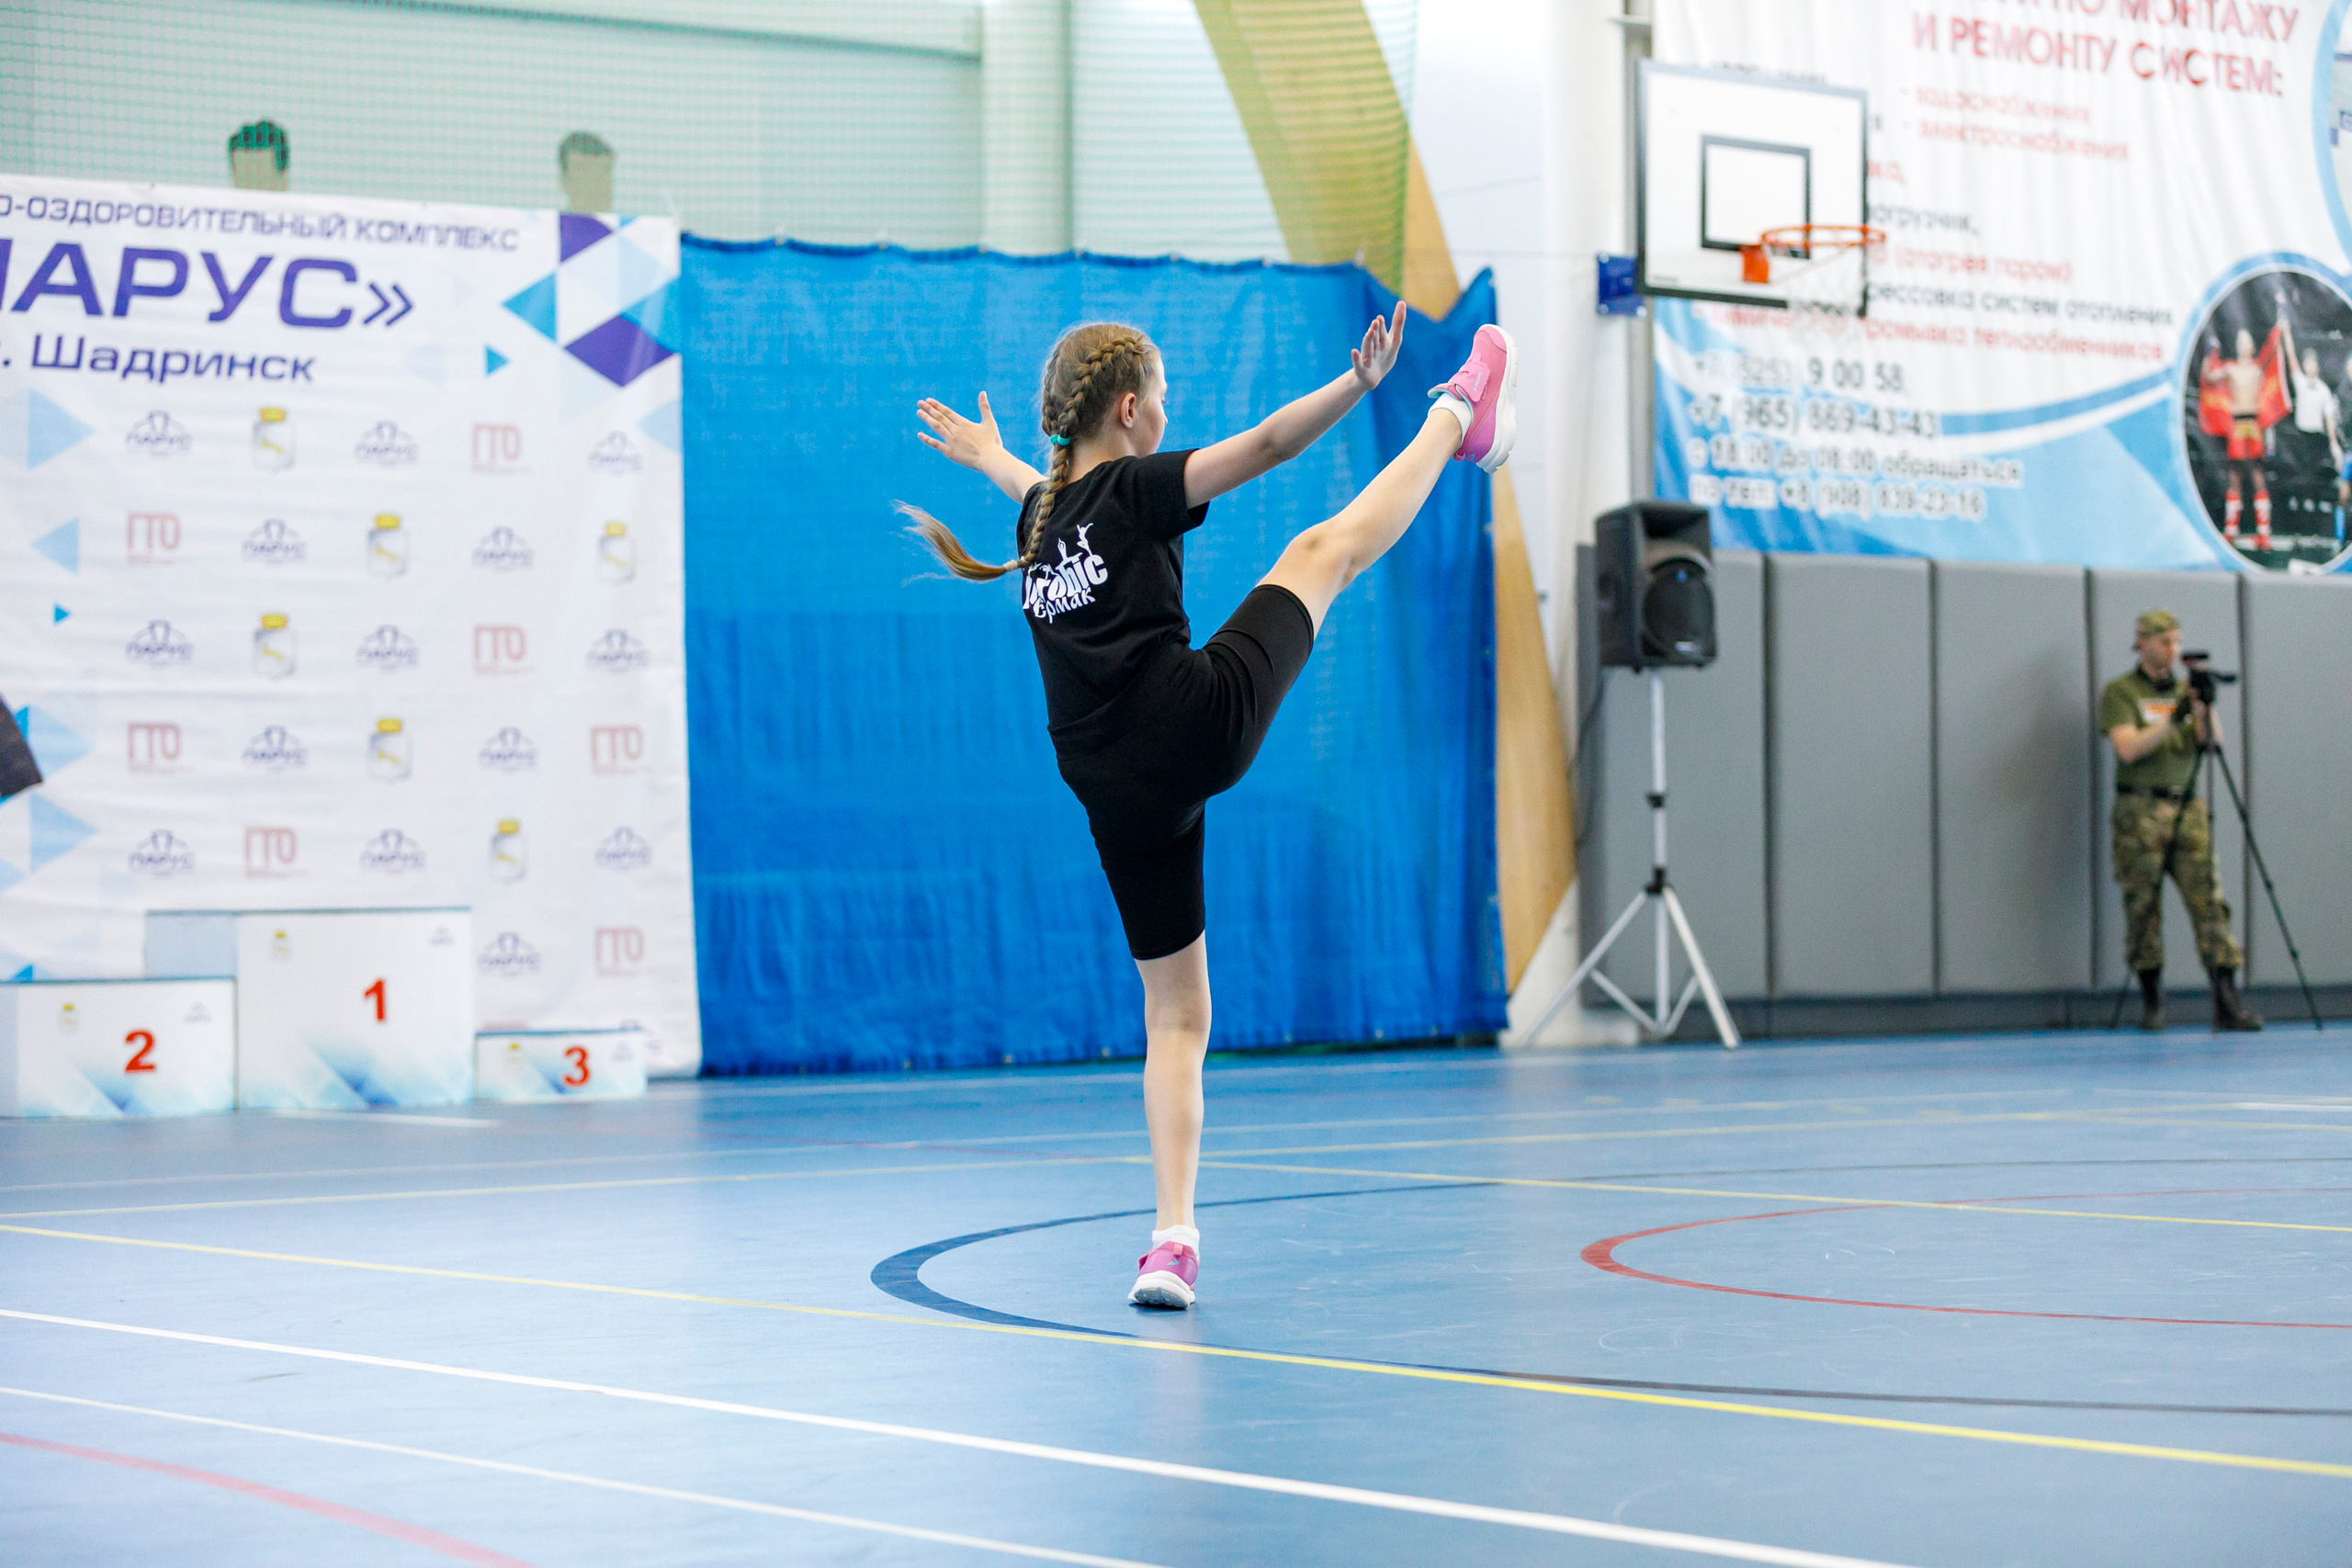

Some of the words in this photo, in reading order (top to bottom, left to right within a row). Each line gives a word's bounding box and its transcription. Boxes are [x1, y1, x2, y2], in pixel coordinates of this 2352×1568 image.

[1912, 12, 1936, 52] И
[1949, 16, 2118, 73] РЕМОНТУ
[2129, 41, 2282, 97] СИСТЕМ:
[354, 218, 520, 252] КОМПЛЕКС
[0, 237, 414, 329] АРУС»
[31, 333, 315, 384] Шадринск
[363, 979, 388, 1022] 1
[125, 1029, 156, 1073] 2
[563, 1045, 591, 1087] 3
